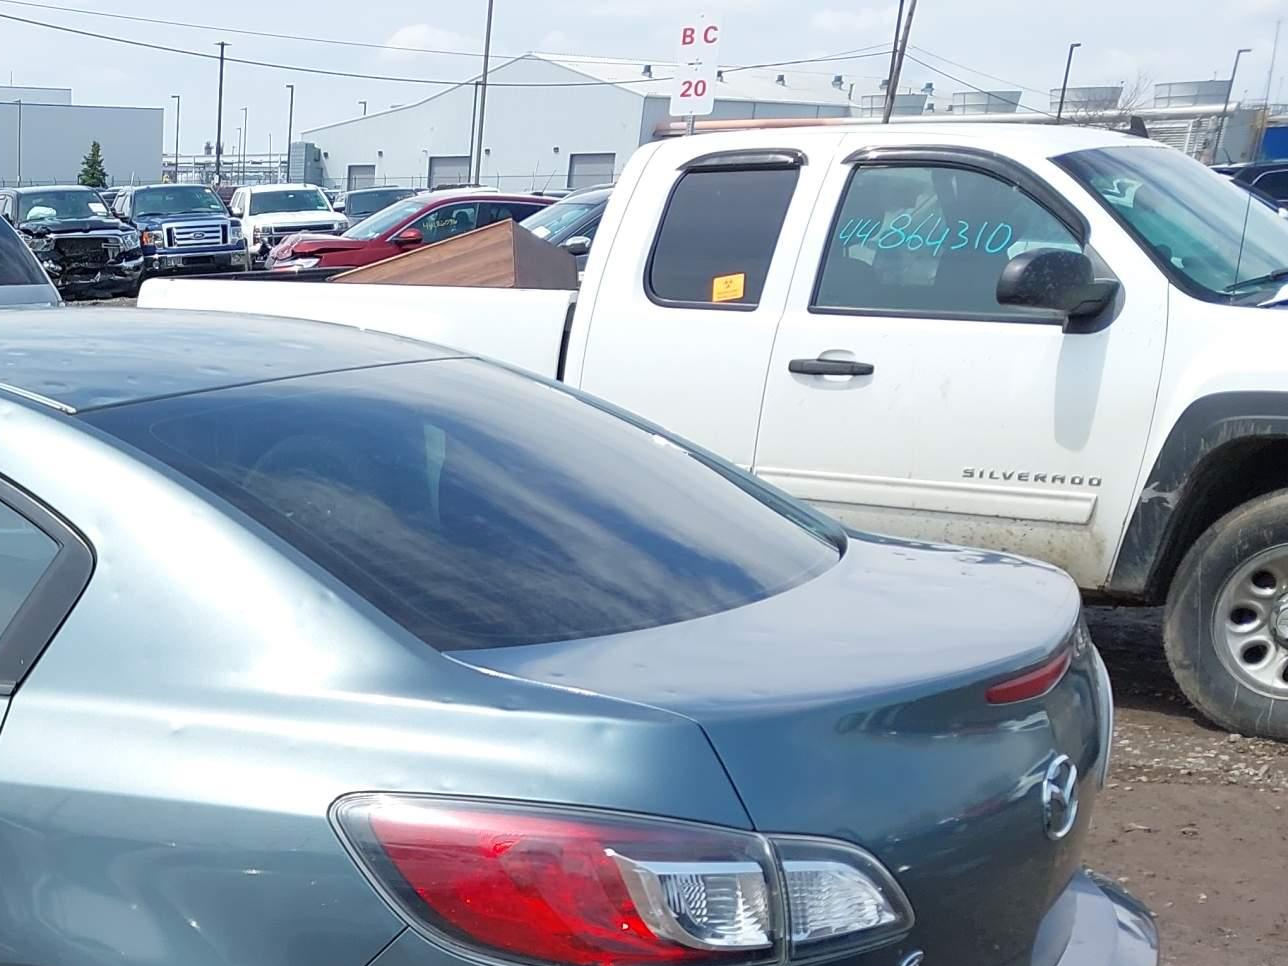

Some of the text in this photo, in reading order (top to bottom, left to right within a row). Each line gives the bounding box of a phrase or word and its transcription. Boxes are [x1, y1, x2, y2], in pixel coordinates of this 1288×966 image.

[681, 25, 719, 46] B C
[679, 79, 707, 98] 20
[839, 213, 1013, 256] 44864310
[961, 467, 1103, 487] SILVERADO
